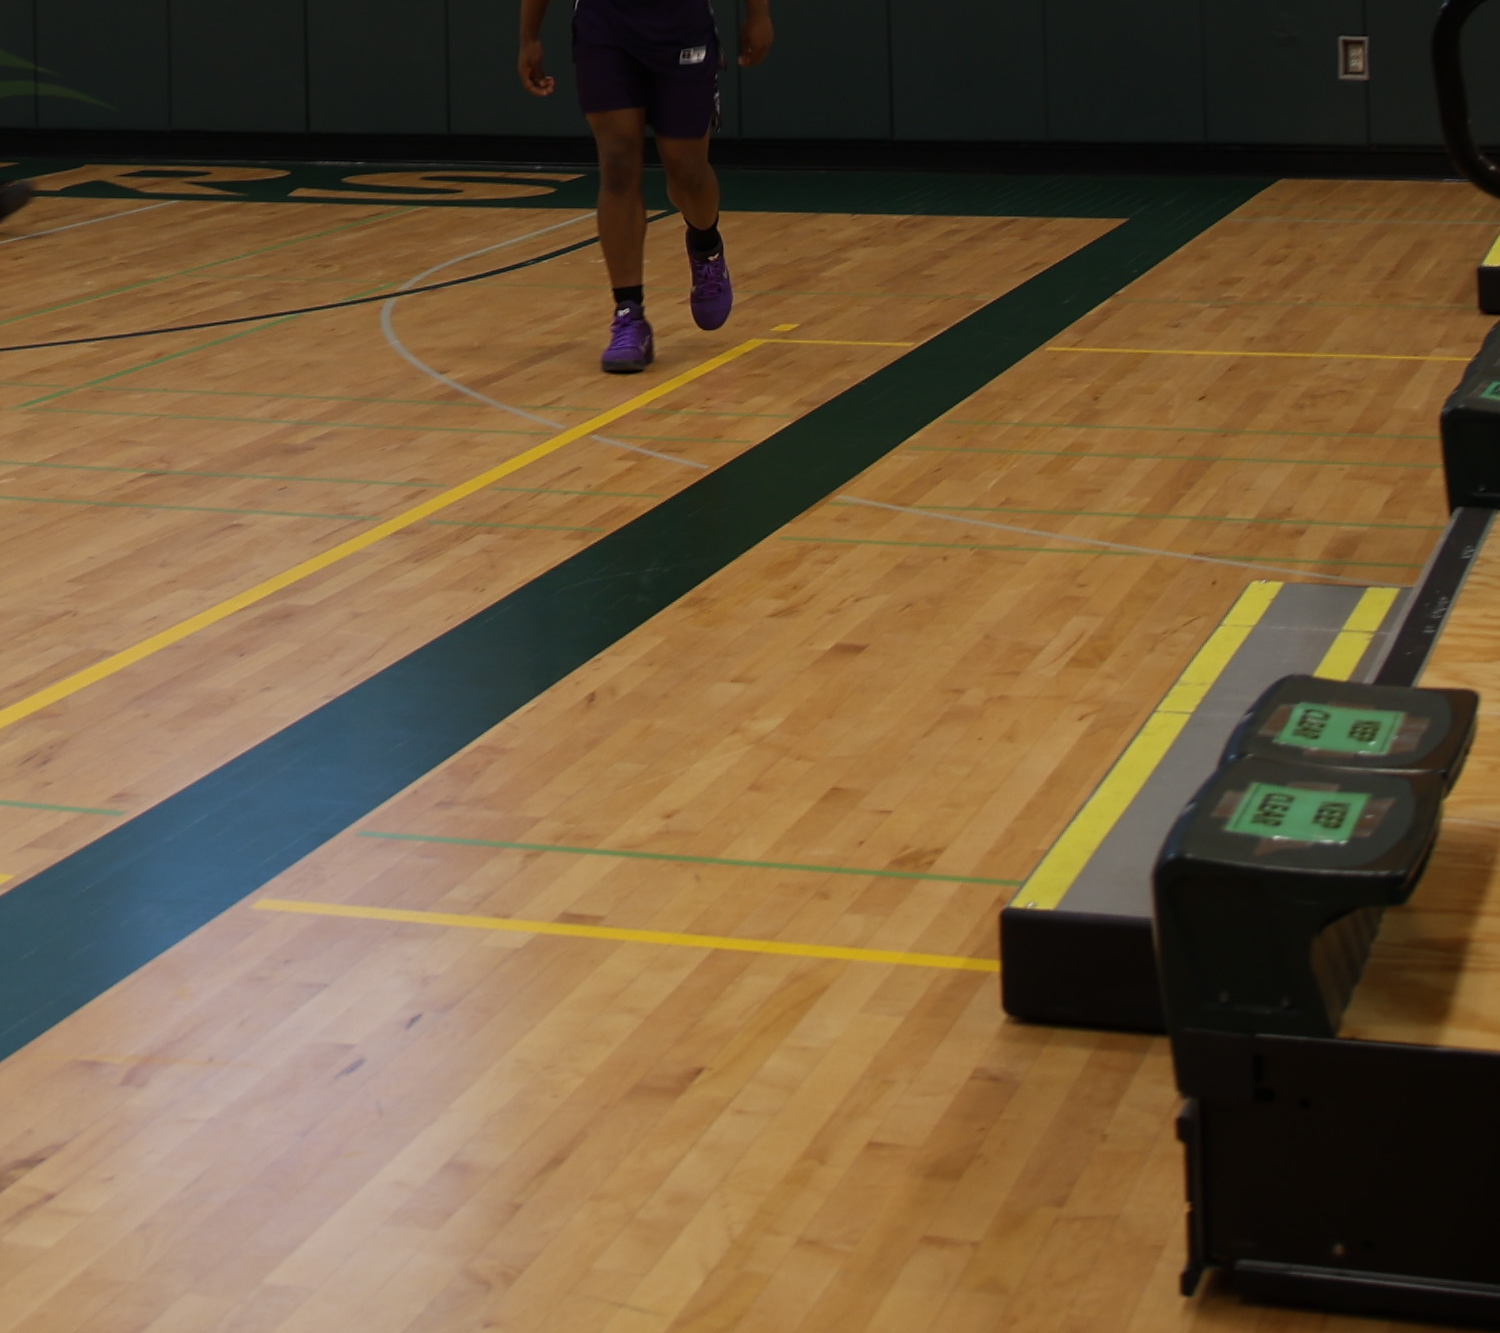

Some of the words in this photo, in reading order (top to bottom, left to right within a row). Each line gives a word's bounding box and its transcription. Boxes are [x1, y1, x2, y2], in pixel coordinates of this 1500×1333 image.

[1292, 708, 1331, 740] CLEAR
[1348, 719, 1382, 742] KEEP
[1250, 792, 1296, 827] CLEAR
[1311, 801, 1351, 829] KEEP
